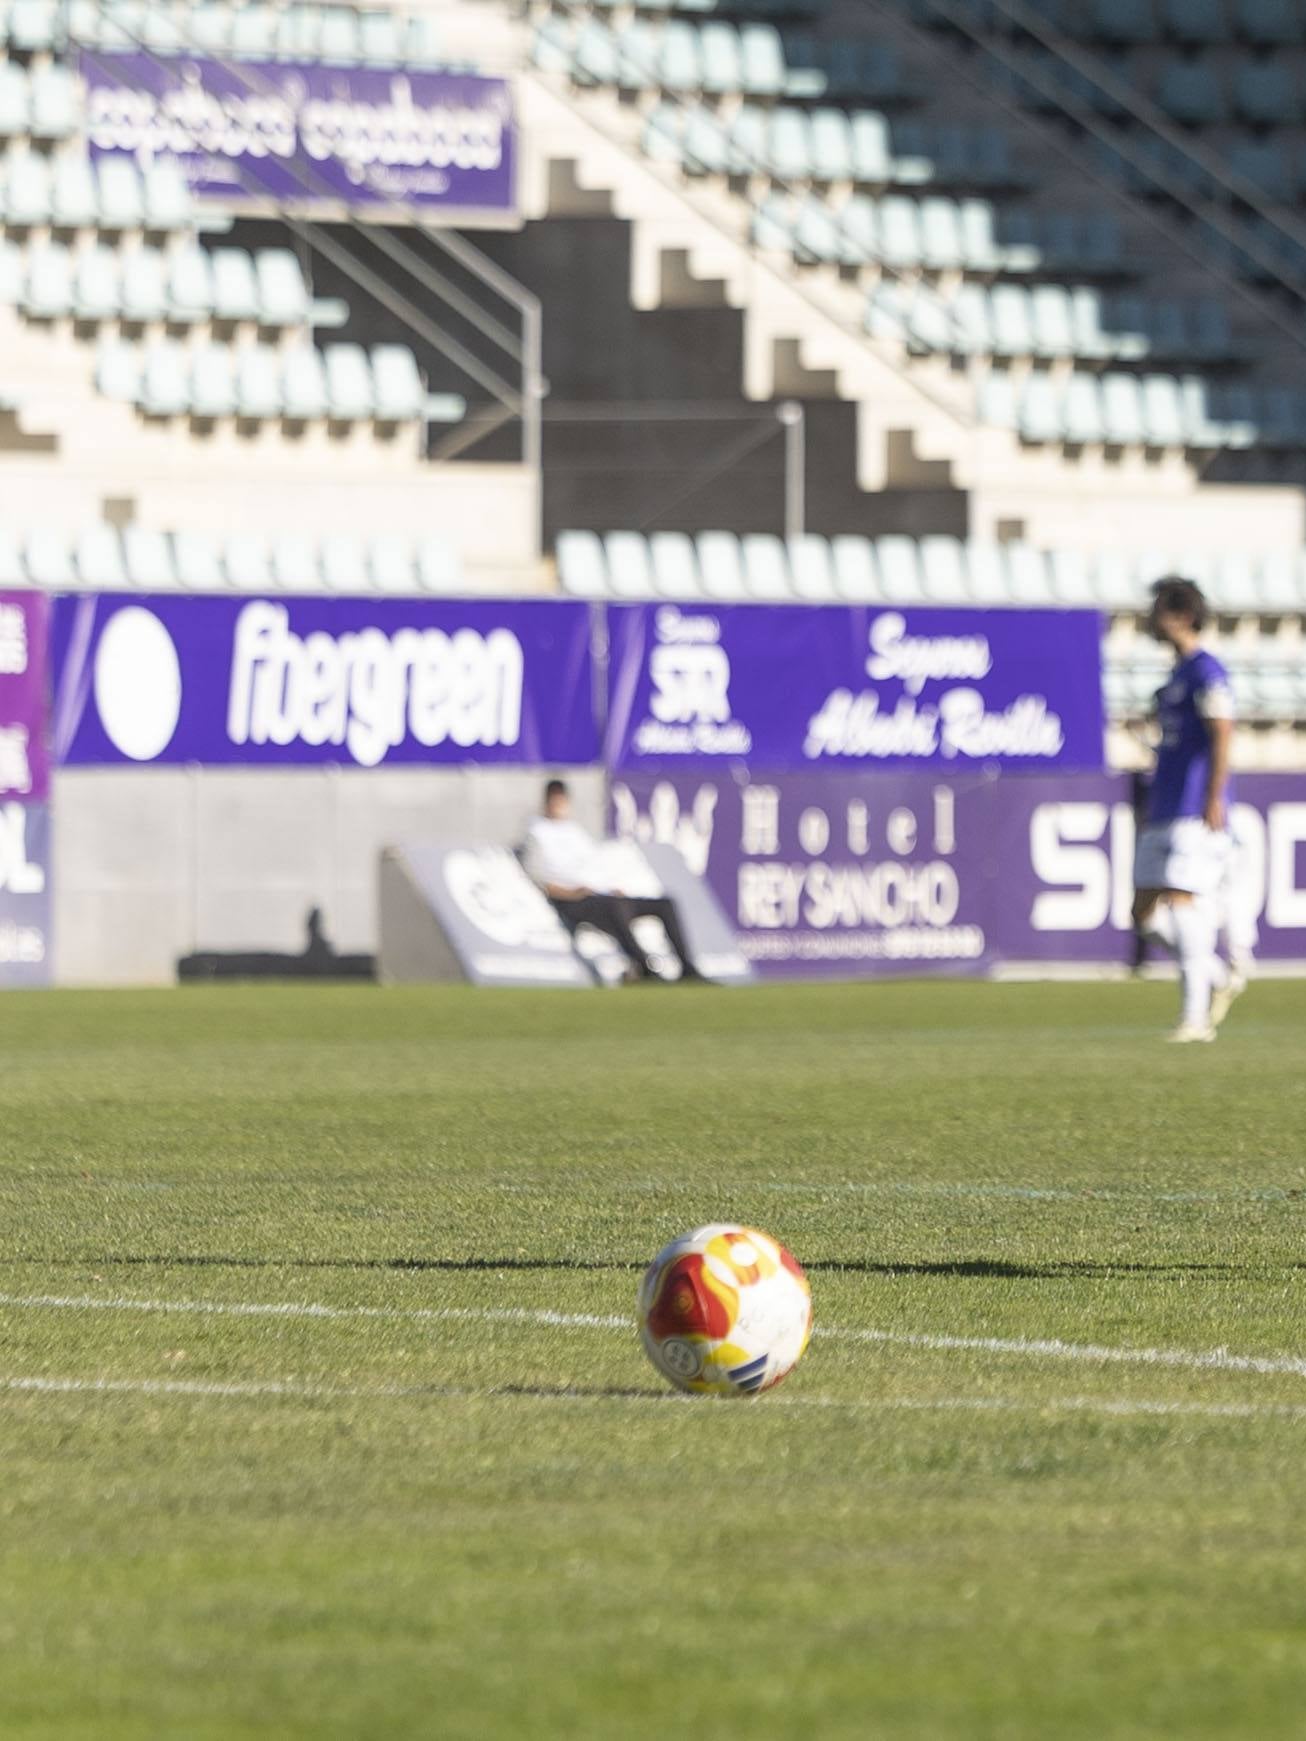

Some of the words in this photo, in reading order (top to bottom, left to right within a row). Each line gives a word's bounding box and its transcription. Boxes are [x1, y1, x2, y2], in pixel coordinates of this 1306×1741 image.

[228, 599, 525, 767] fibergreen
[740, 784, 957, 857] Hotel
[737, 861, 802, 929] REY
[803, 860, 961, 929] SANCHO
